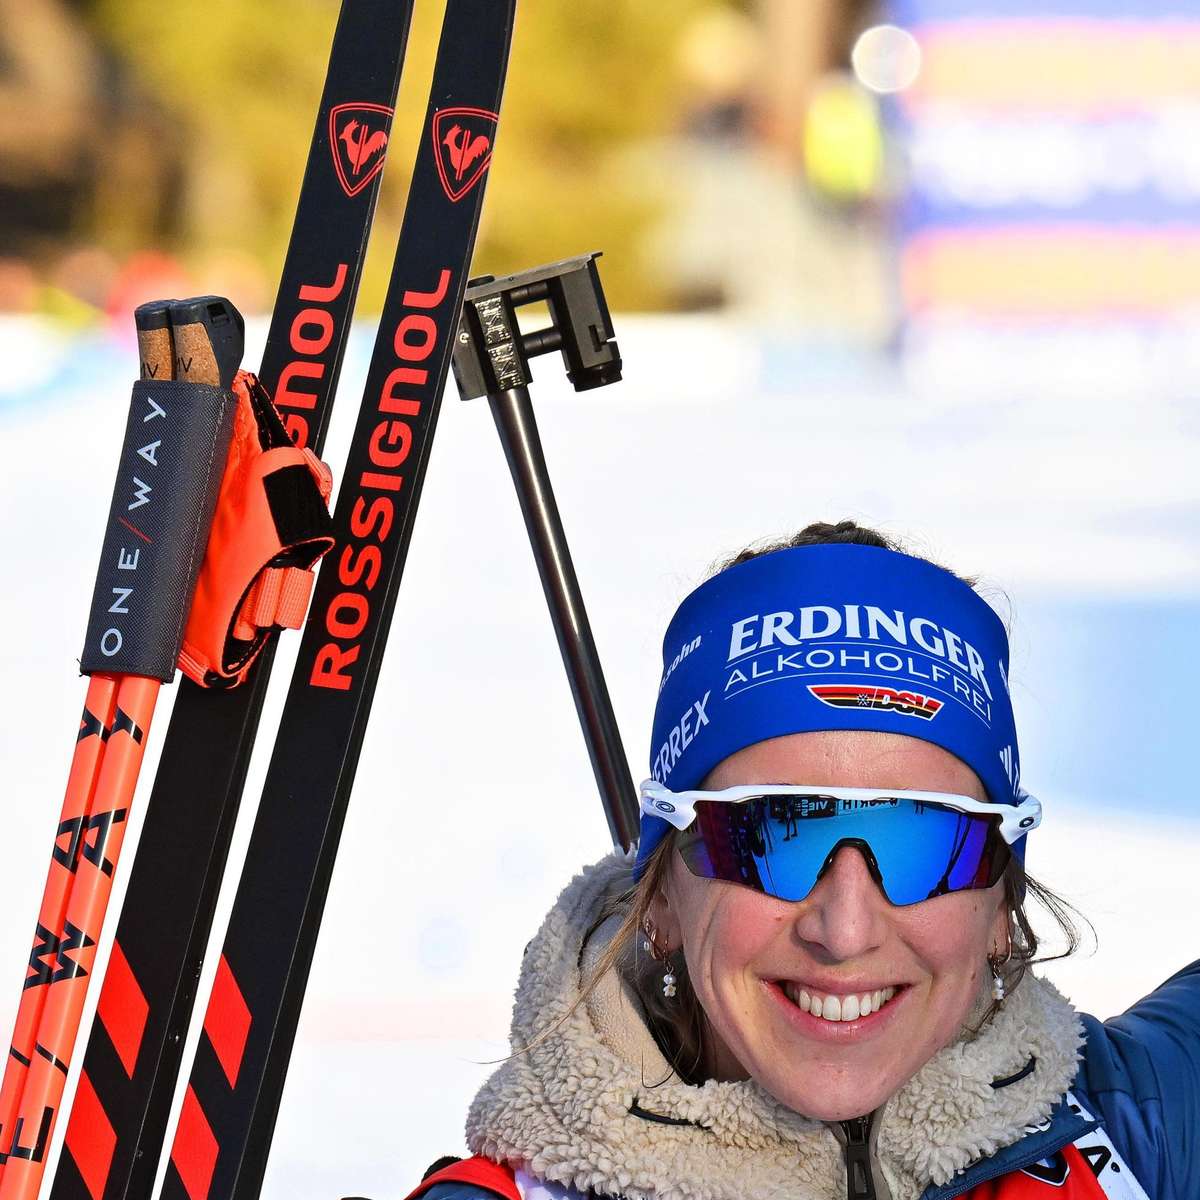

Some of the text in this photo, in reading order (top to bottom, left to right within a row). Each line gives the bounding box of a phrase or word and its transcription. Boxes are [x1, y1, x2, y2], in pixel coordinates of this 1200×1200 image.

[310, 269, 452, 691] ROSSIGNOL
[724, 649, 991, 721] ALKOHOLFREI
[727, 604, 993, 701] ERDINGER
[652, 690, 711, 785] ERREX
